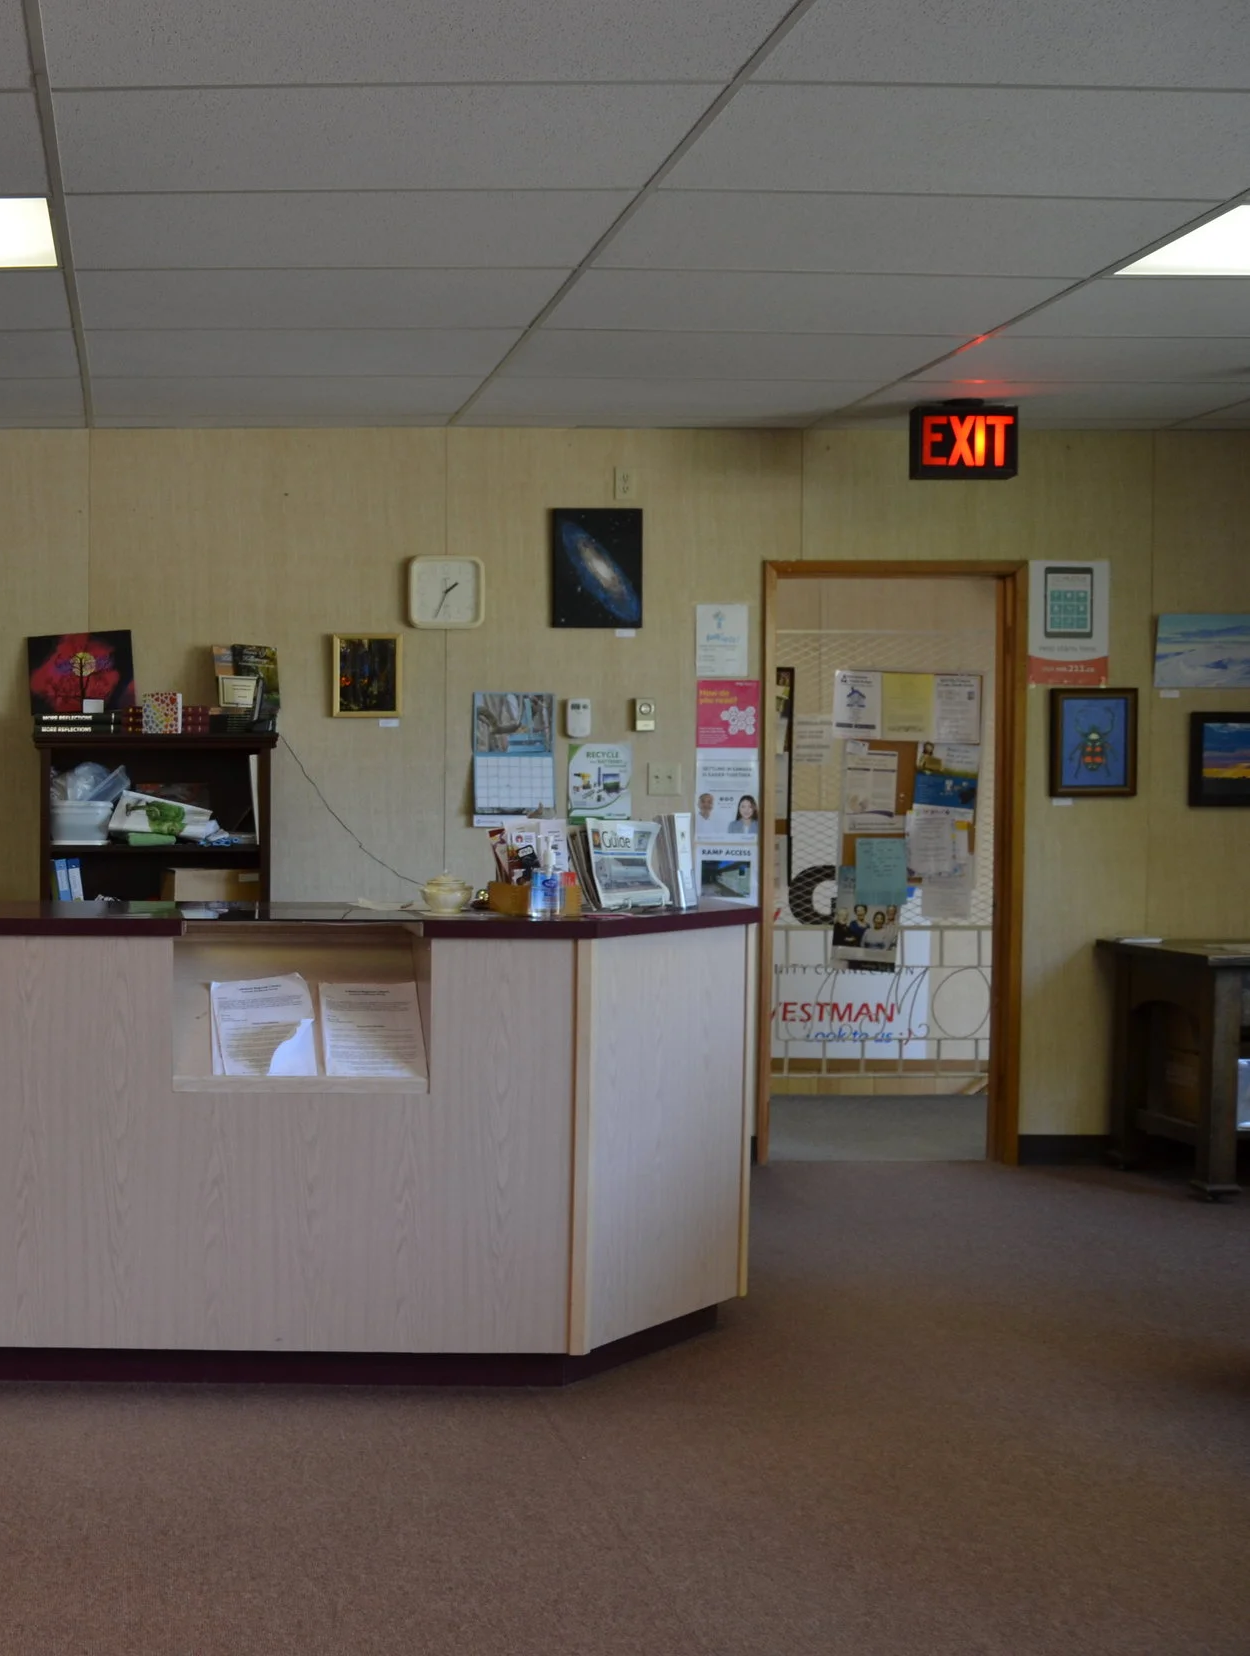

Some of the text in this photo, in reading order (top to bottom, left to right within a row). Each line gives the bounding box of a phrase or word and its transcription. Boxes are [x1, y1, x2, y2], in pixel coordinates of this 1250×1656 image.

[922, 415, 1014, 467] EXIT
[586, 751, 619, 759] RECYCLE
[601, 829, 631, 848] Guide
[702, 848, 752, 857] RAMP ACCESS
